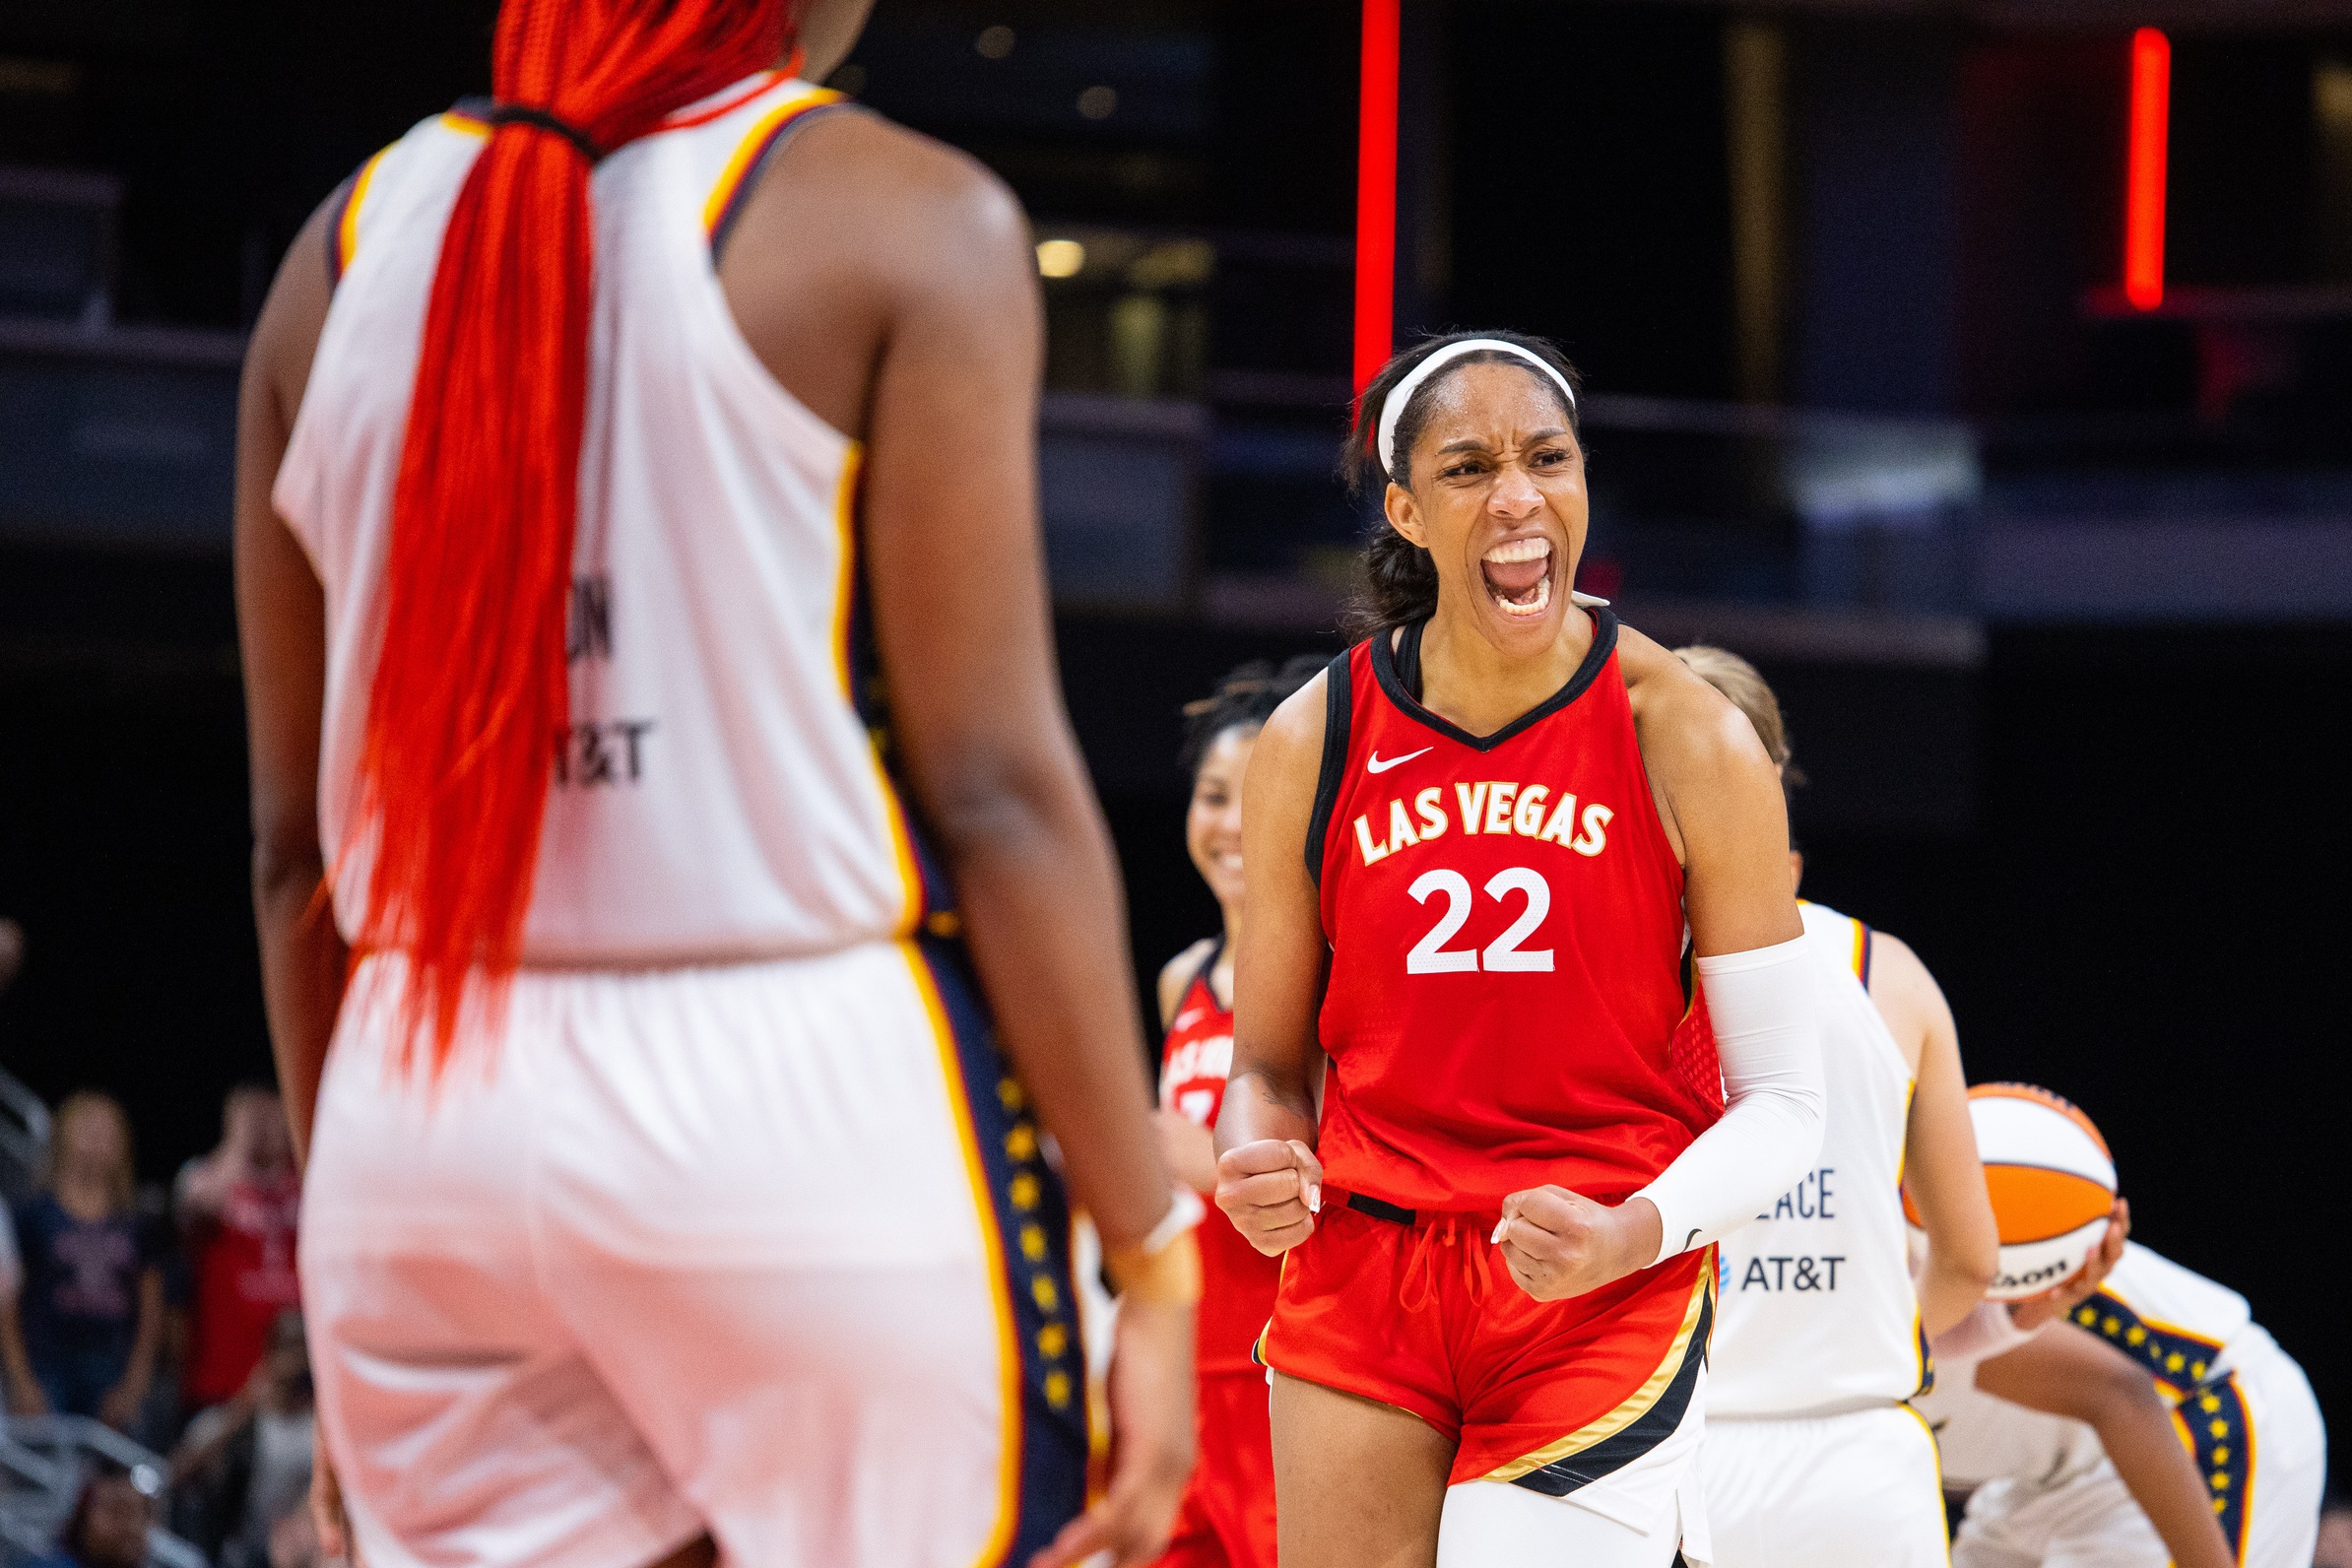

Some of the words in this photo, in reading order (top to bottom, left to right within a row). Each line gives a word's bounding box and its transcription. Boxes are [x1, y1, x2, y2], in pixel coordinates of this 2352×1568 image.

[1353, 786, 1449, 867] LAS
[1455, 781, 1614, 857] VEGAS
[1406, 867, 1555, 974] 22
[1755, 1168, 1835, 1219] ACE
[1740, 1257, 1847, 1292] AT&T
